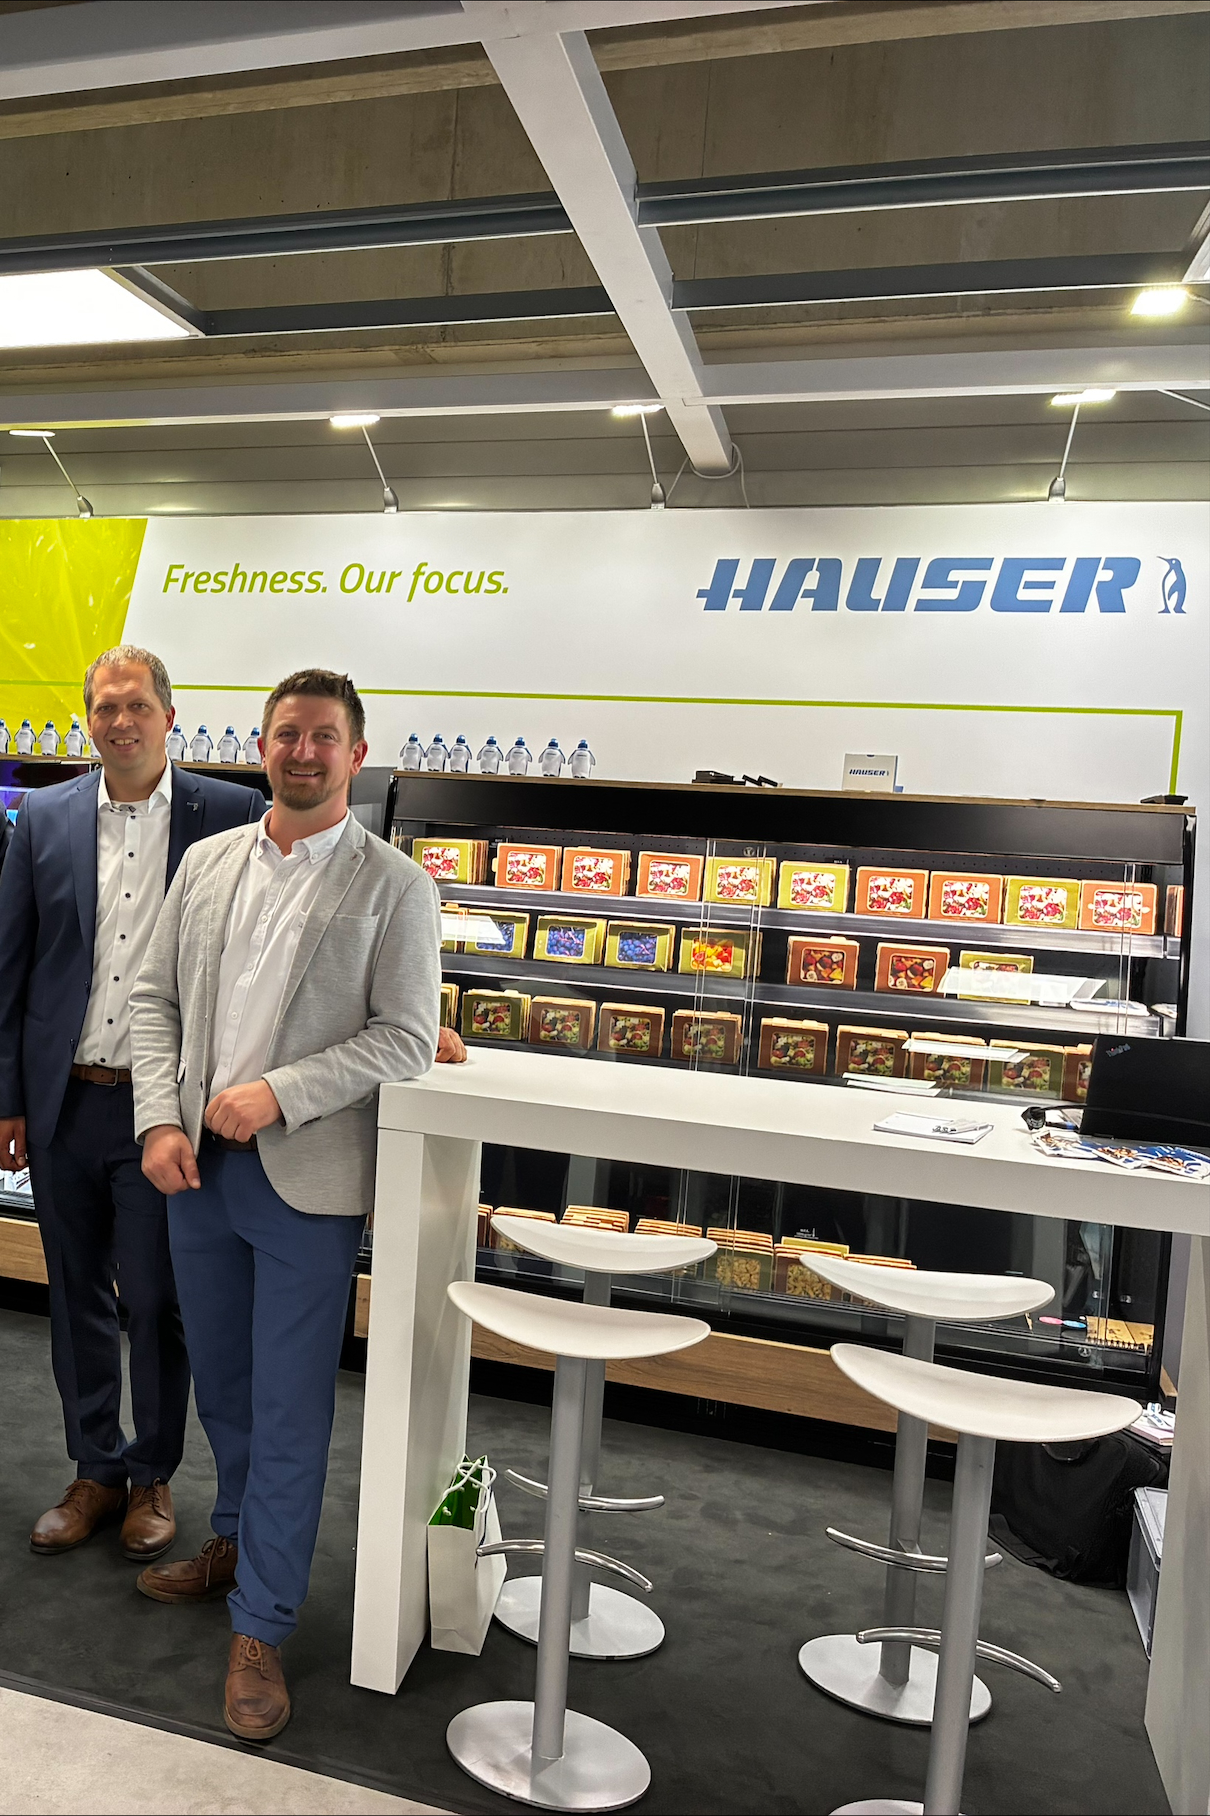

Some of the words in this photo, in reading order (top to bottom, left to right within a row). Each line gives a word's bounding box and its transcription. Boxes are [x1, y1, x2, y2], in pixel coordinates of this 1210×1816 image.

[162, 563, 328, 595] Freshness.
[339, 563, 403, 595] Our
[407, 561, 509, 603] focus.
[696, 557, 1141, 612] HAUSER
